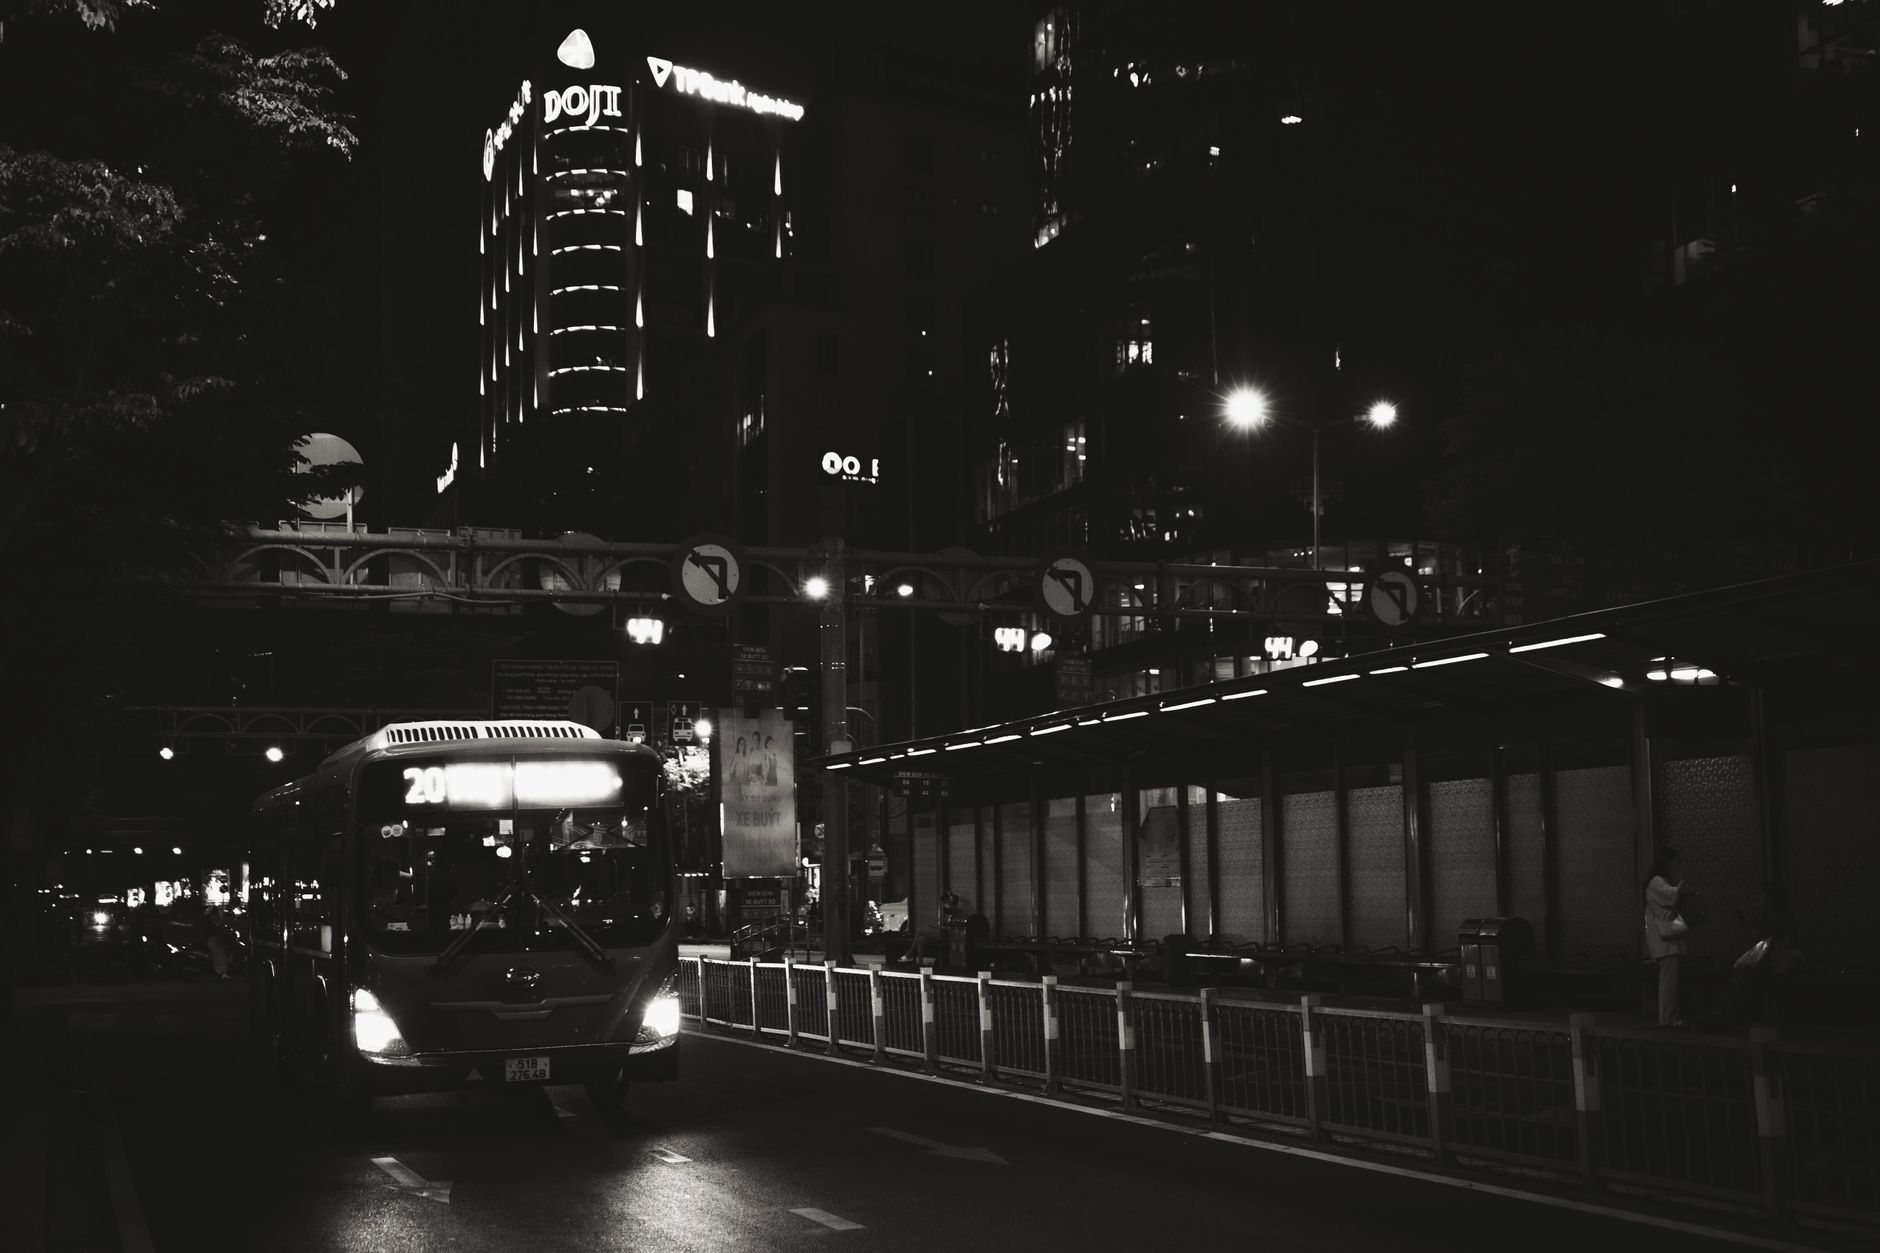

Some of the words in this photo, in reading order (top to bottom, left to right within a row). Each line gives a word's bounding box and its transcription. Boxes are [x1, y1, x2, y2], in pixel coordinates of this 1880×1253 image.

[543, 84, 622, 127] DOJI
[1264, 636, 1293, 659] 44
[403, 766, 446, 804] 20
[736, 810, 750, 827] XE
[517, 1058, 538, 1069] 51B
